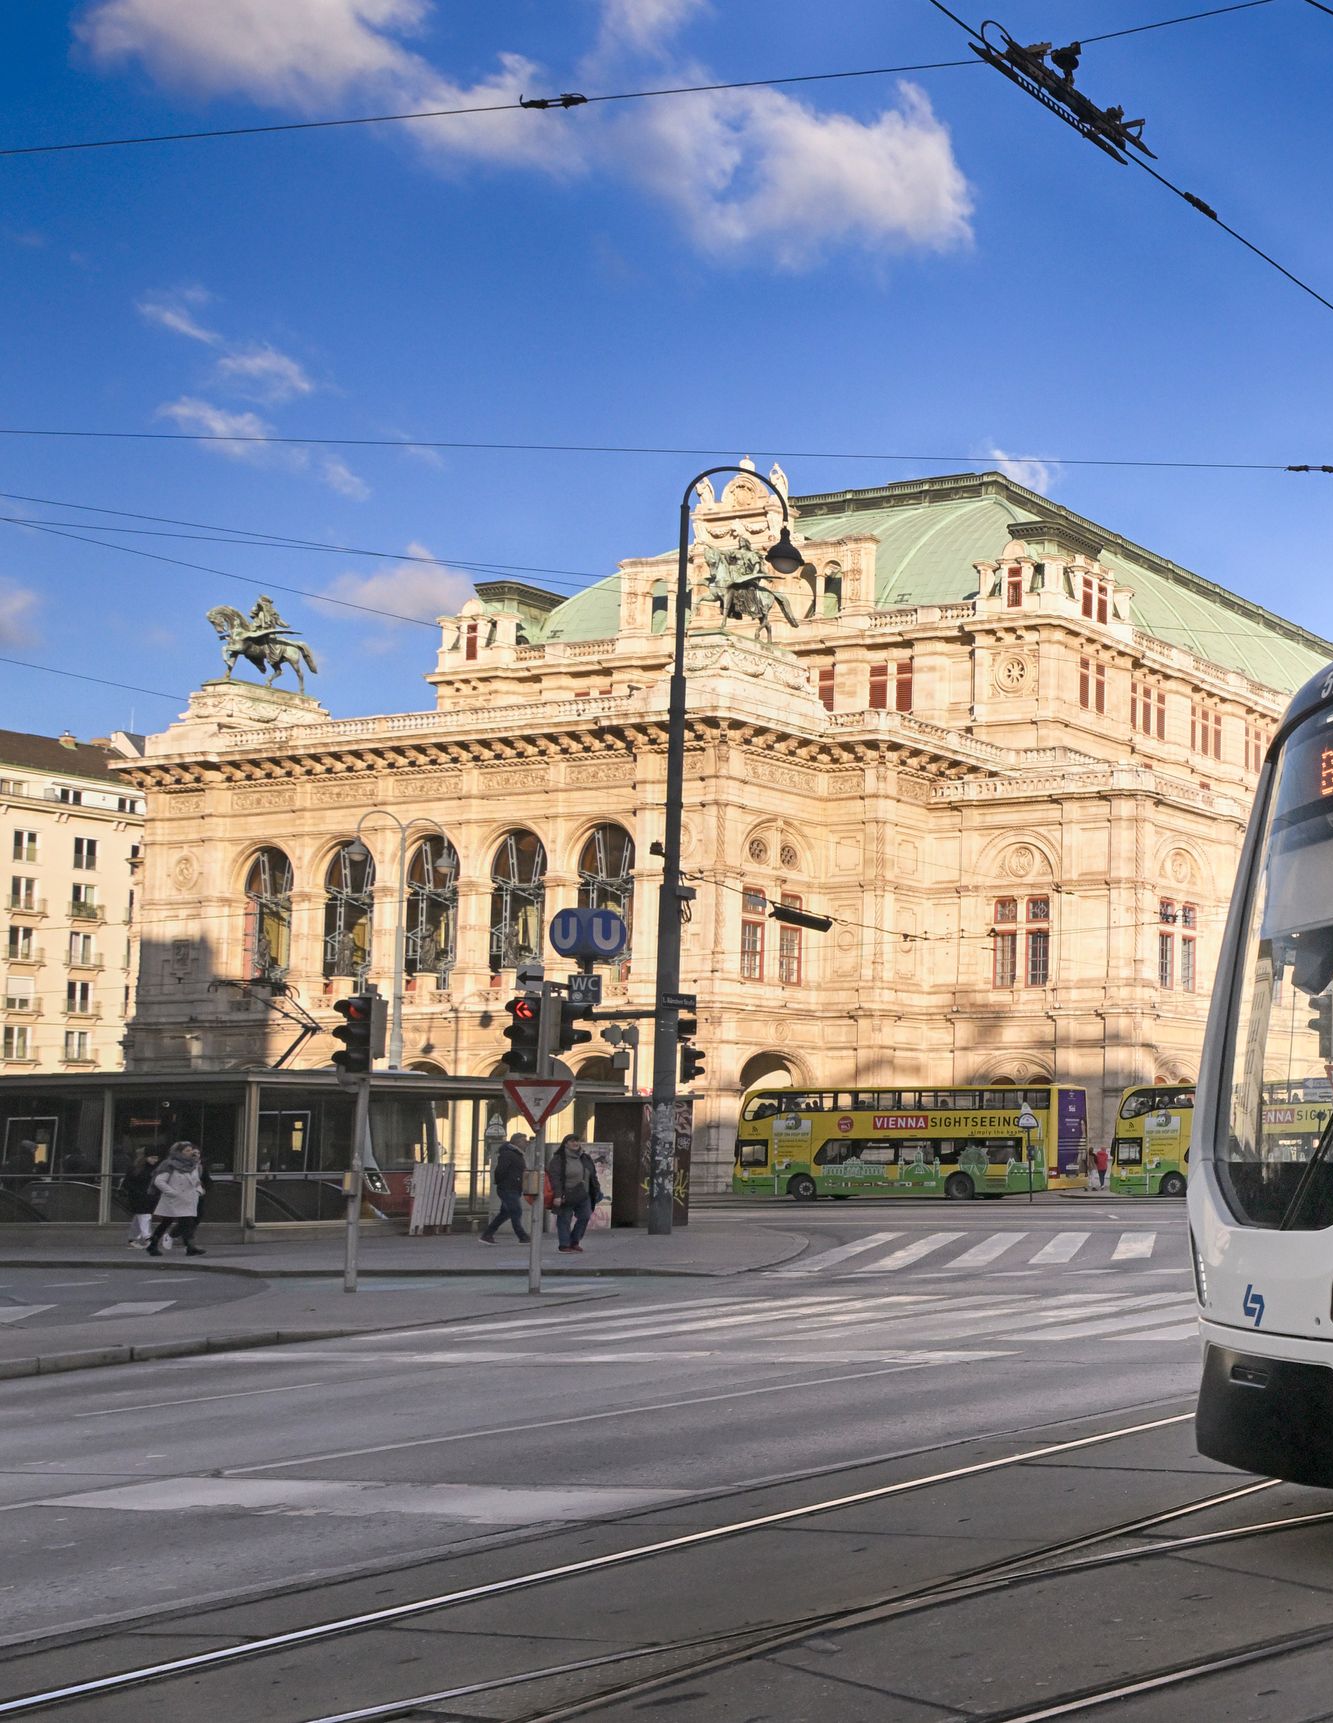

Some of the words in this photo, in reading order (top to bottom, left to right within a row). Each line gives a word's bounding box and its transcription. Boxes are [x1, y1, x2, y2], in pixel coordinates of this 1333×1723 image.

[554, 917, 577, 950] U
[593, 917, 620, 950] U
[571, 977, 598, 991] WC
[875, 1116, 926, 1128] VIENNA
